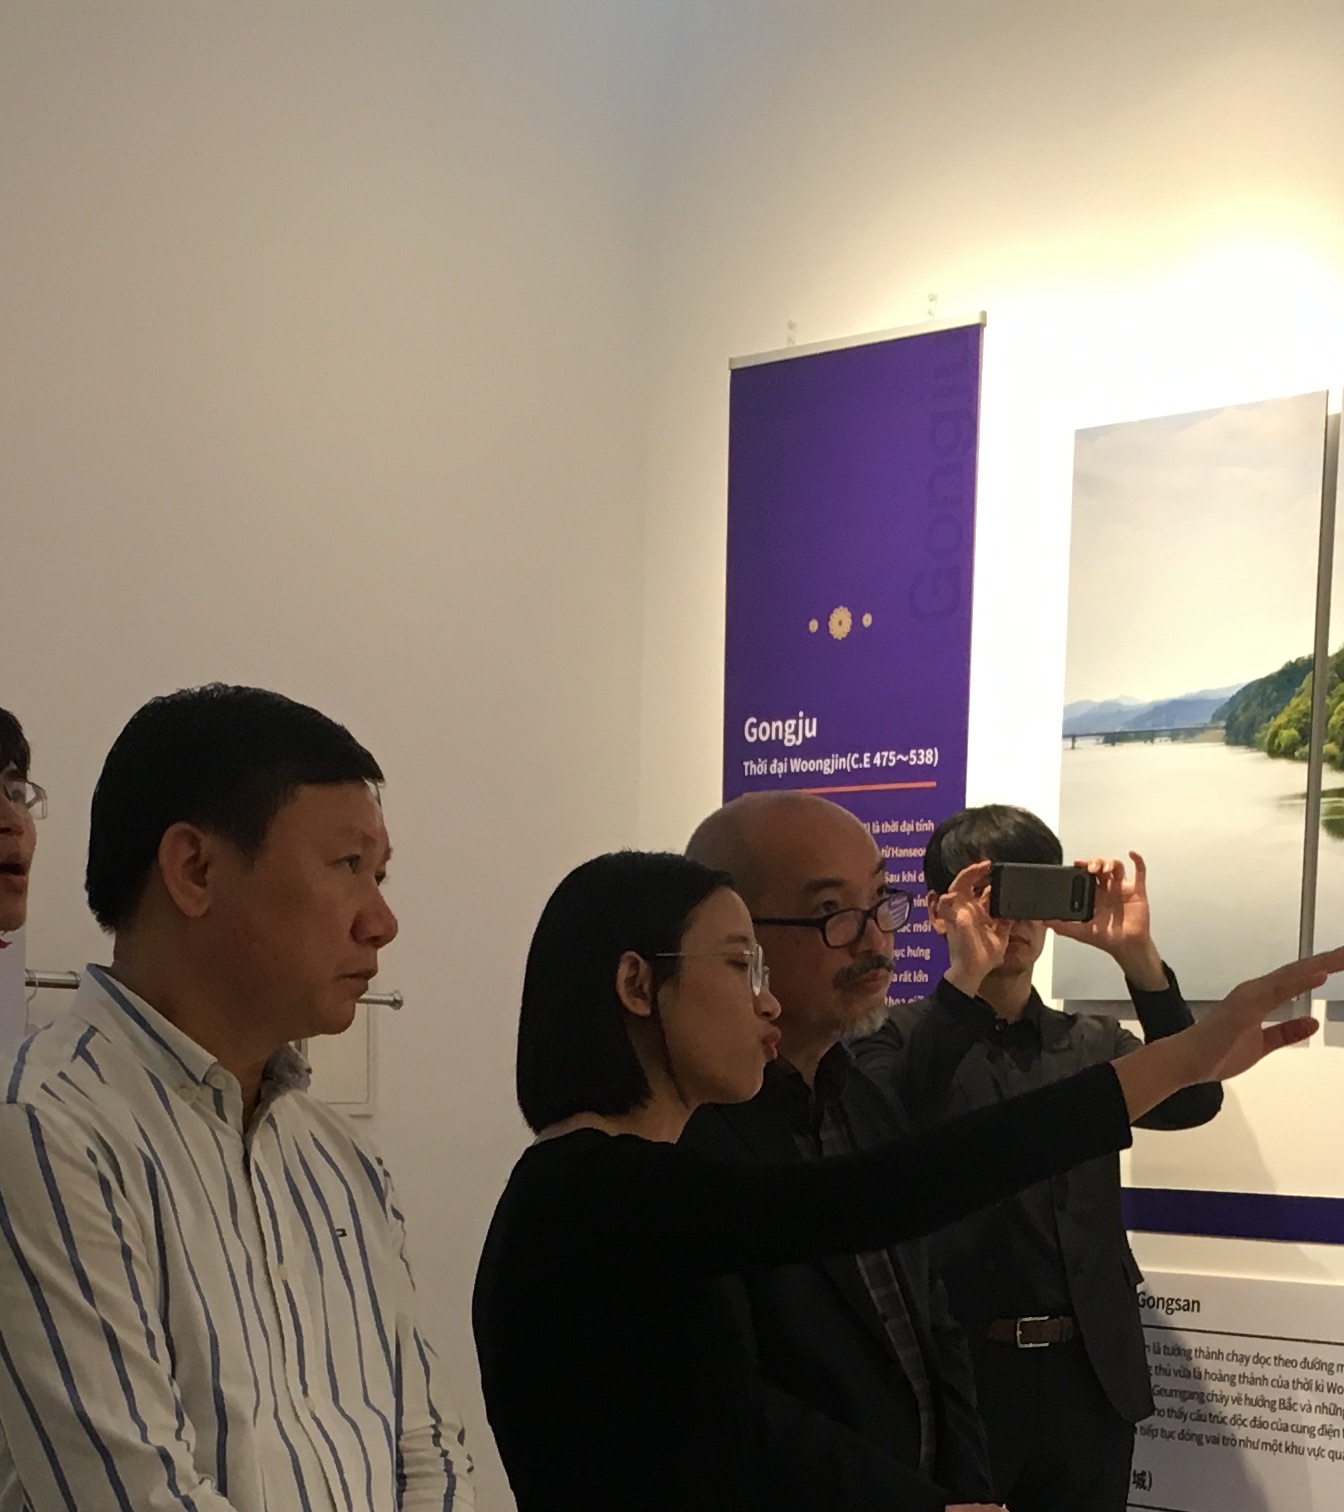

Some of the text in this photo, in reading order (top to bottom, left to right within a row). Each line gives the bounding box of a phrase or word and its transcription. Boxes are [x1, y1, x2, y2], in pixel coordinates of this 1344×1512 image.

[744, 711, 817, 746] Gongju
[743, 758, 767, 776] Thời
[770, 757, 788, 778] đại
[1137, 1291, 1201, 1315] Gongsan
[1194, 1346, 1224, 1361] thành
[1225, 1350, 1250, 1366] chạy
[1251, 1352, 1272, 1368] dọc
[1273, 1354, 1298, 1368] theo
[1299, 1357, 1335, 1375] đường
[1193, 1367, 1202, 1380] là
[1204, 1368, 1237, 1387] hoàng
[1238, 1372, 1268, 1386] thành
[1270, 1375, 1289, 1389] của
[1291, 1378, 1313, 1391] thời
[1206, 1390, 1229, 1407] chảy
[1244, 1393, 1277, 1413] hướng
[1278, 1396, 1298, 1412] Bắc
[1299, 1400, 1312, 1413] và
[1208, 1411, 1228, 1425] trúc
[1229, 1414, 1248, 1428] độc
[1249, 1416, 1269, 1430] đáo
[1270, 1418, 1289, 1432] của
[1290, 1424, 1316, 1438] cung
[1317, 1424, 1340, 1440] điện
[1177, 1429, 1204, 1446] đóng
[1205, 1433, 1220, 1445] vai
[1221, 1434, 1237, 1447] trò
[1238, 1437, 1261, 1450] như
[1261, 1439, 1283, 1455] một
[1284, 1441, 1305, 1455] khu
[1306, 1446, 1326, 1460] vực
